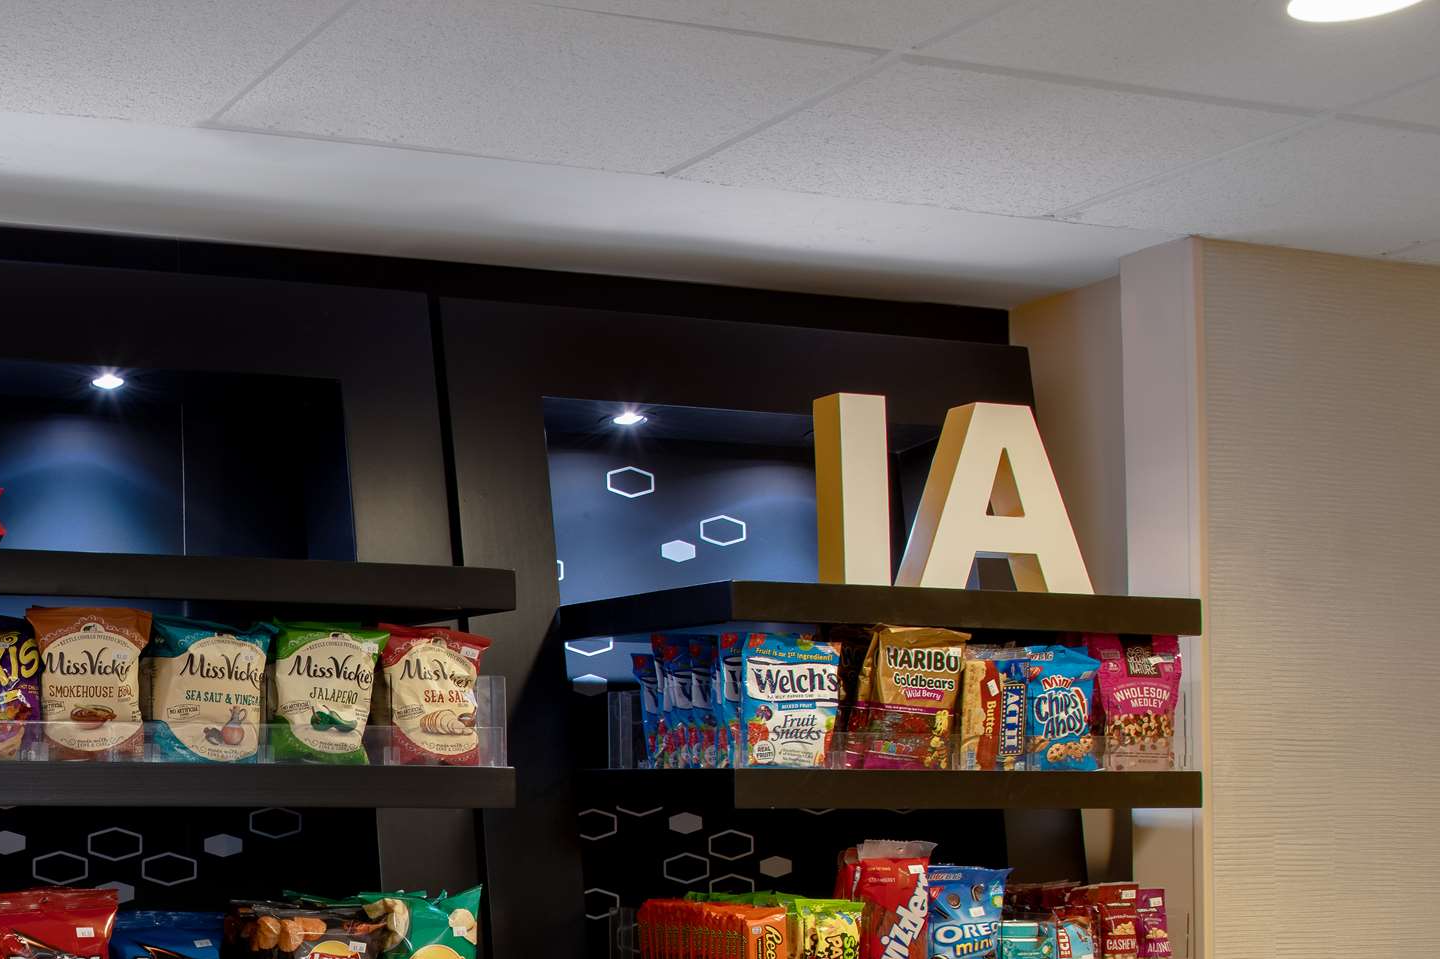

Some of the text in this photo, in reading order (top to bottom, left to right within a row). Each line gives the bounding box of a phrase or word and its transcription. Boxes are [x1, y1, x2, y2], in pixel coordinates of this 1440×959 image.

[45, 651, 87, 675] Miss
[180, 653, 225, 679] Miss
[288, 655, 333, 678] Miss
[886, 647, 959, 672] HARIBO
[751, 667, 839, 694] Welch's
[893, 672, 955, 691] Goldbears
[1041, 676, 1073, 689] Mini
[49, 685, 114, 698] SMOKEHOUSE
[185, 689, 233, 705] SEA SALT &
[424, 689, 445, 703] SEA
[905, 688, 942, 701] Wild Berry
[1035, 690, 1080, 722] Chips
[1130, 698, 1163, 709] MEDLEY
[782, 714, 817, 729] Fruit
[771, 725, 822, 742] Snacks
